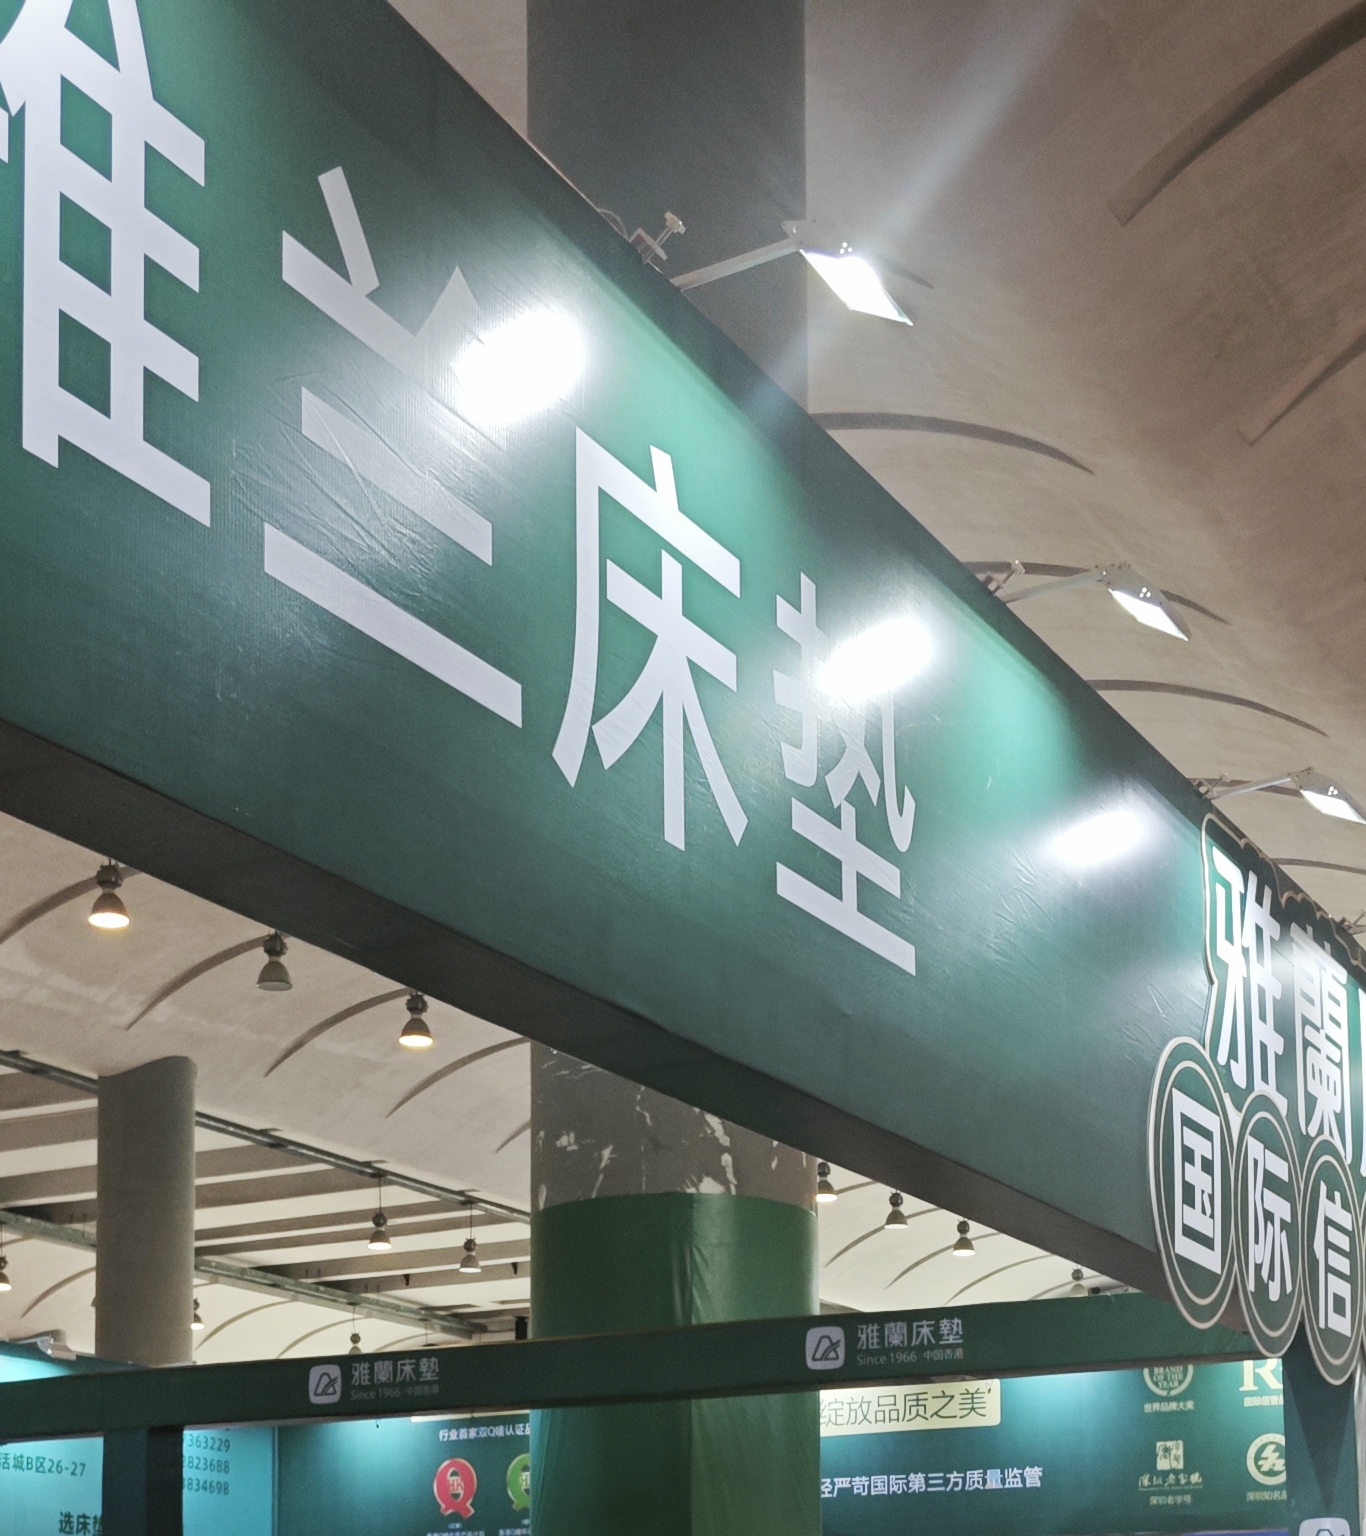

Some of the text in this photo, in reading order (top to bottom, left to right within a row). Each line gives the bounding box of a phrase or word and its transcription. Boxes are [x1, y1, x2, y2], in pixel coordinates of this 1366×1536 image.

[855, 1317, 964, 1351] 雅蘭床墊
[350, 1356, 440, 1387] 雅蘭床墊
[856, 1354, 887, 1367] Since
[889, 1352, 917, 1364] 1966
[820, 1388, 987, 1427] 绽放品质之美
